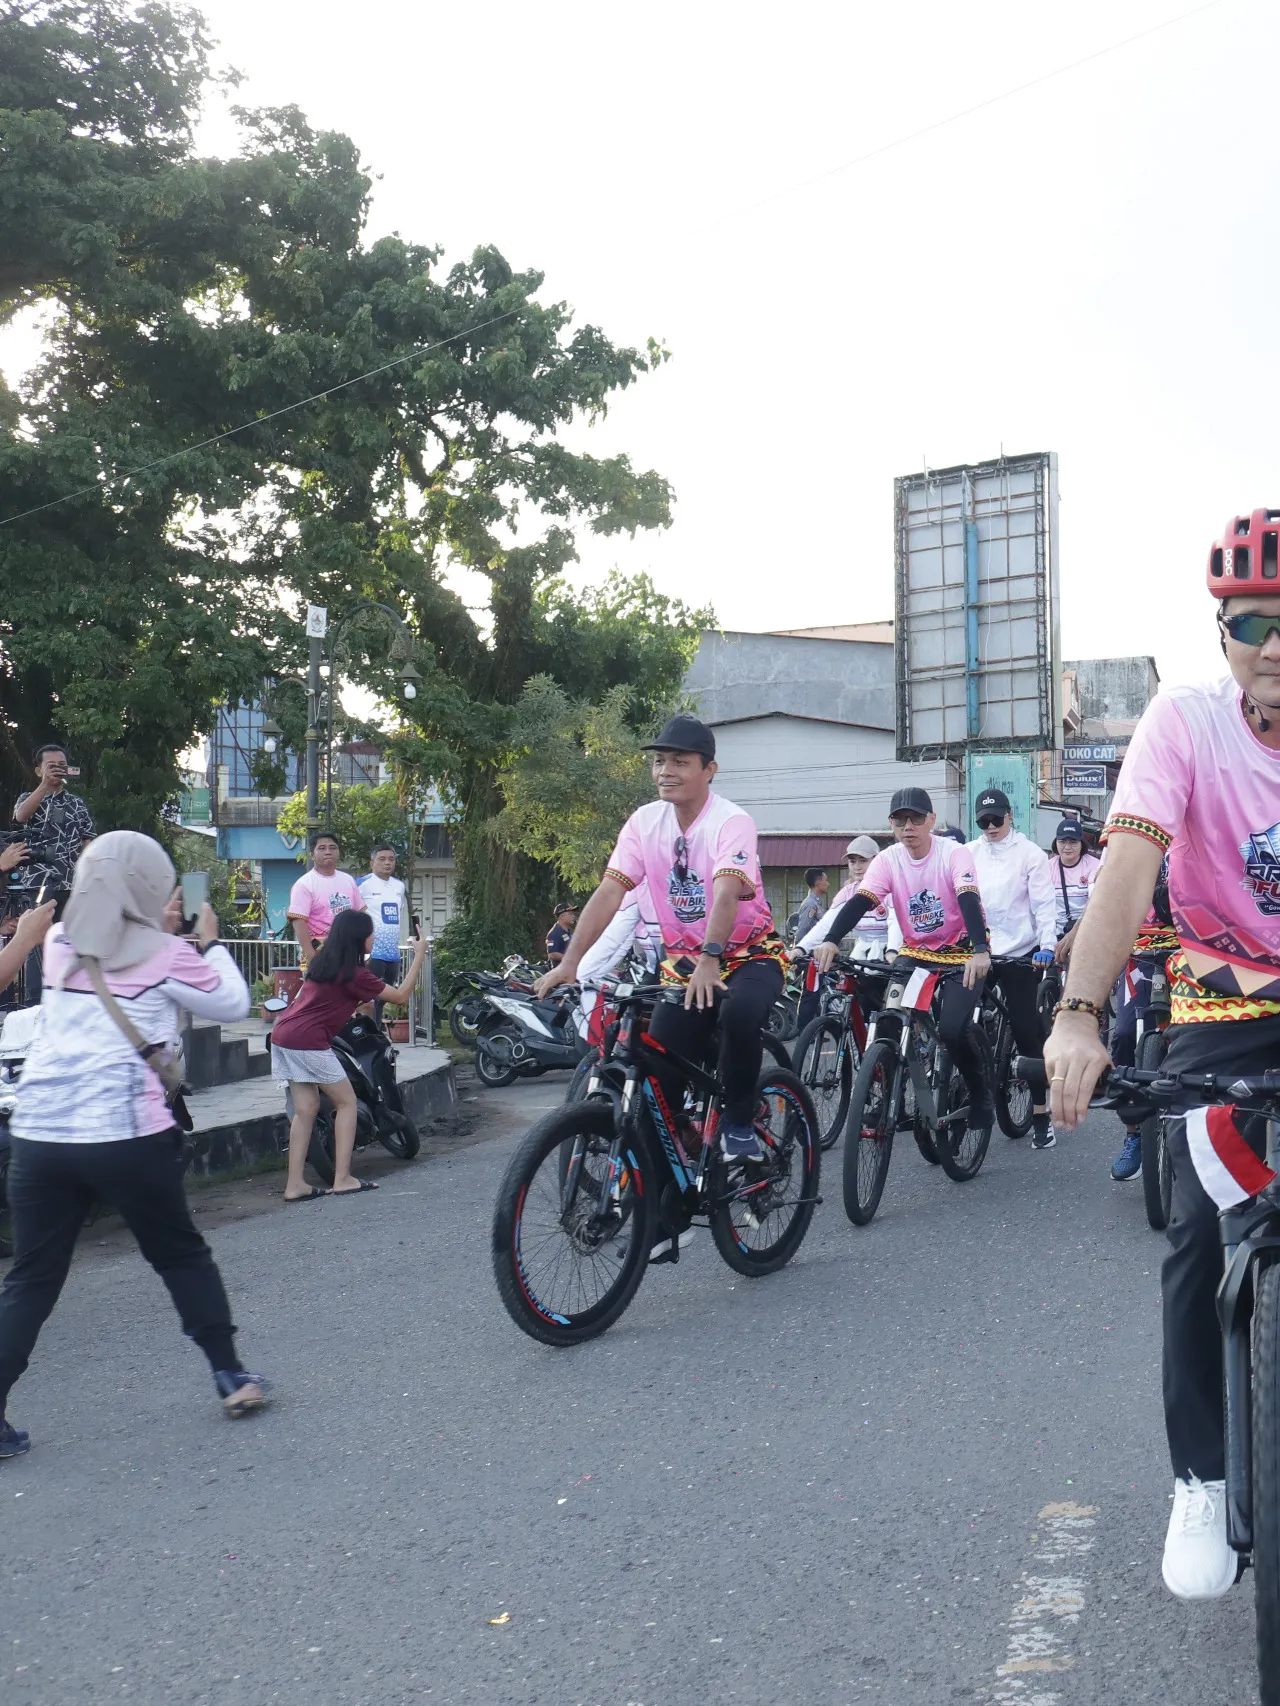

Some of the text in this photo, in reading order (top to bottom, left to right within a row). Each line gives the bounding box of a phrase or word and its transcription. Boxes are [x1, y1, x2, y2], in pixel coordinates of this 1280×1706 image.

[1063, 747, 1114, 760] TOKO CAT
[1066, 774, 1098, 782] Dulux
[982, 796, 995, 805] alo
[383, 906, 398, 916] BRI
